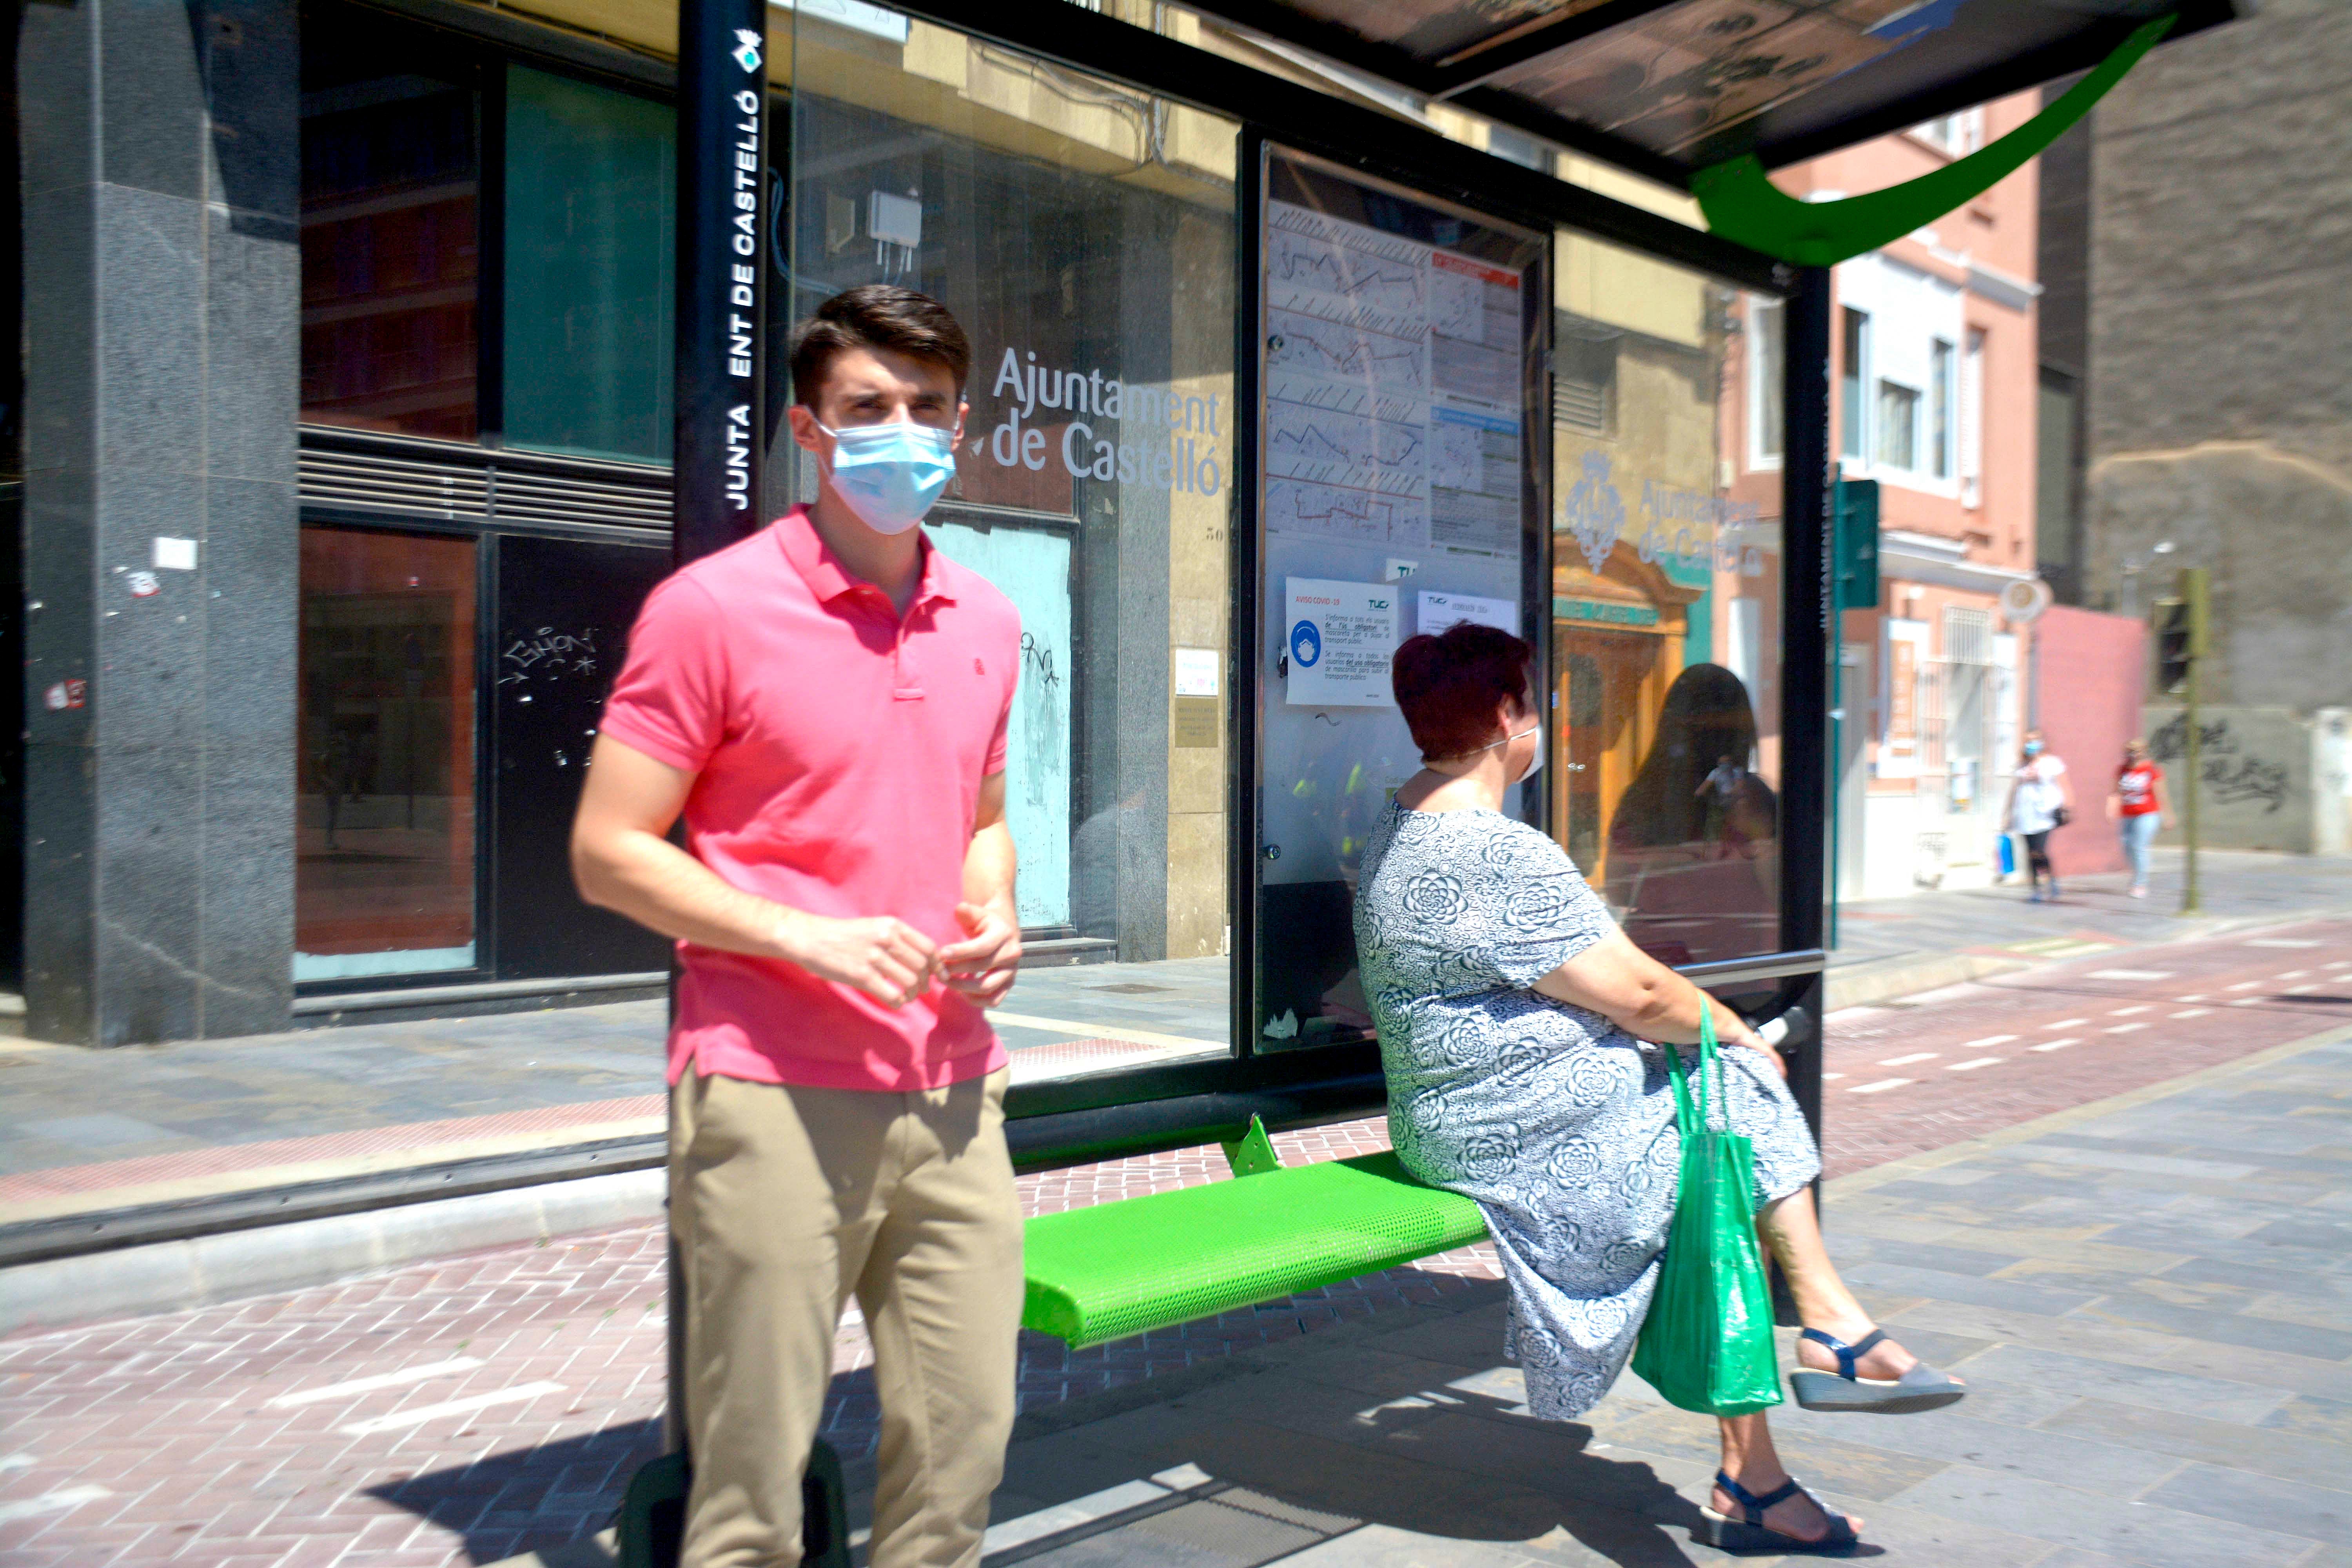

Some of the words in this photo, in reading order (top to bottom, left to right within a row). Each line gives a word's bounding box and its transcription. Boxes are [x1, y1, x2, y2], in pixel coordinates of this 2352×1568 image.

[731, 90, 759, 256] CASTELLÓ
[730, 263, 754, 307] DE
[728, 314, 753, 377] ENT
[993, 347, 1219, 437] Ajuntament
[725, 405, 750, 510] JUNTA
[993, 408, 1045, 470] de
[1062, 422, 1220, 497] Castelló
[1639, 529, 1667, 565] de
[1368, 600, 1389, 609] TUC
